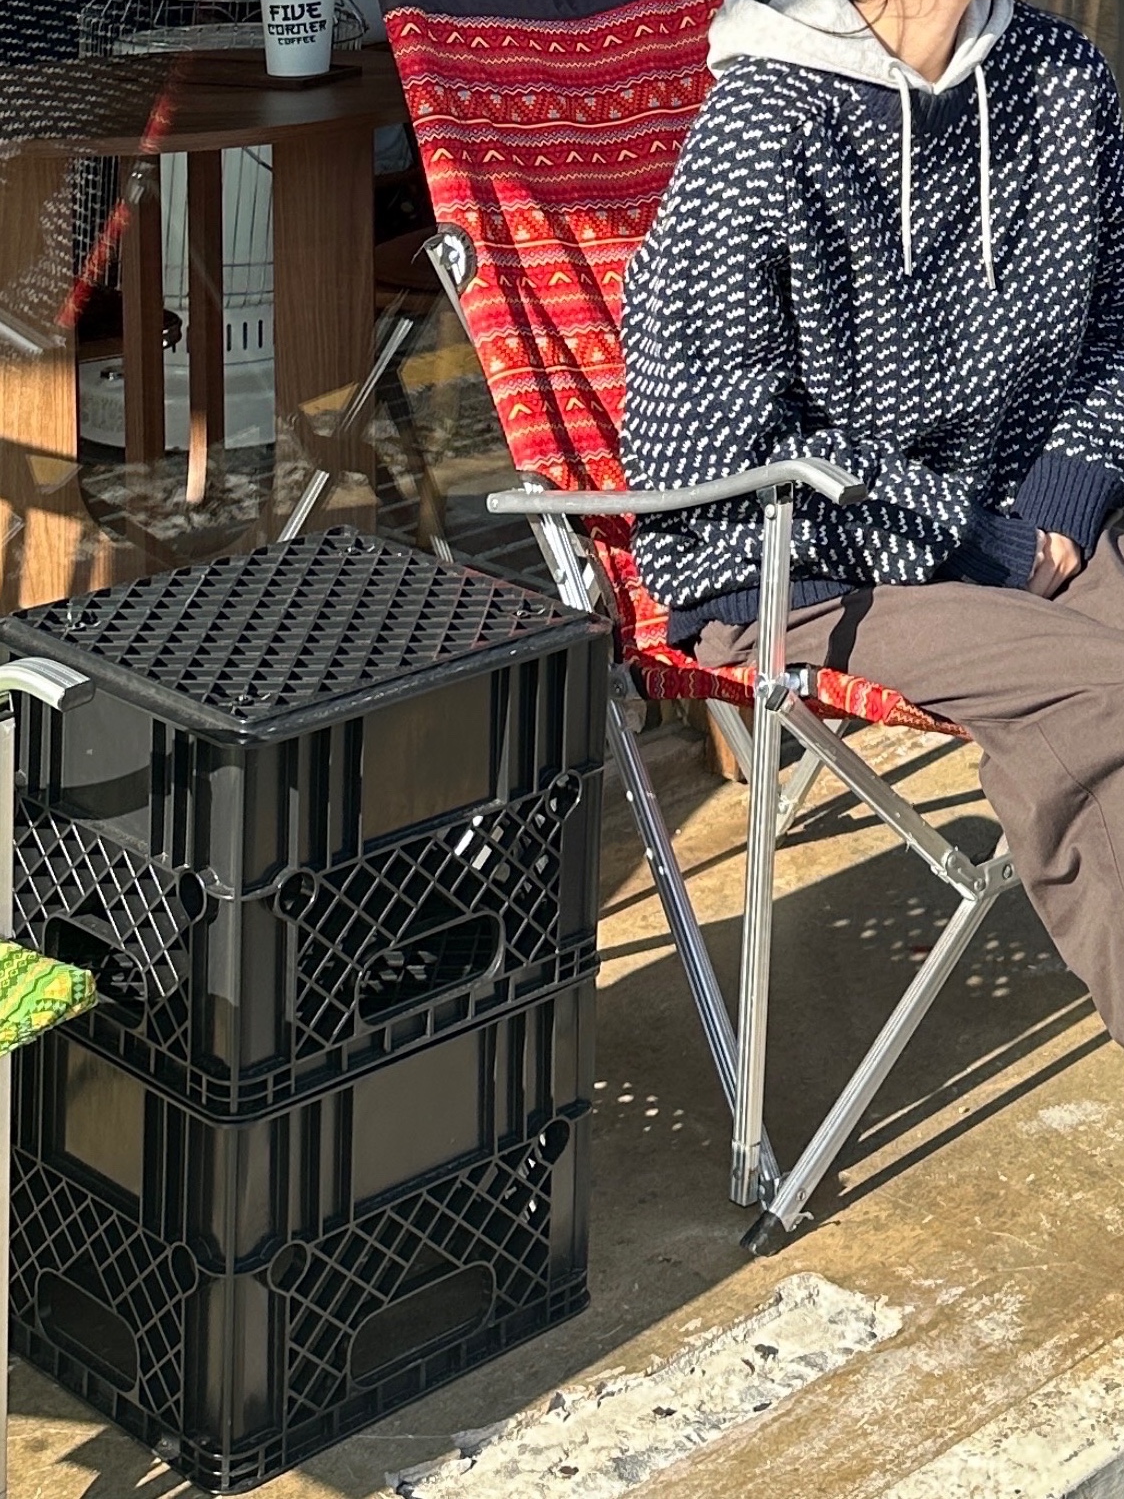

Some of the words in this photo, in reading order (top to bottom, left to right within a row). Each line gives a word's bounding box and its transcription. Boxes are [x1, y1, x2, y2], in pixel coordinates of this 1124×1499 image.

[269, 1, 322, 21] FIVE
[267, 19, 327, 36] CORNER
[278, 35, 317, 45] COFFEE
